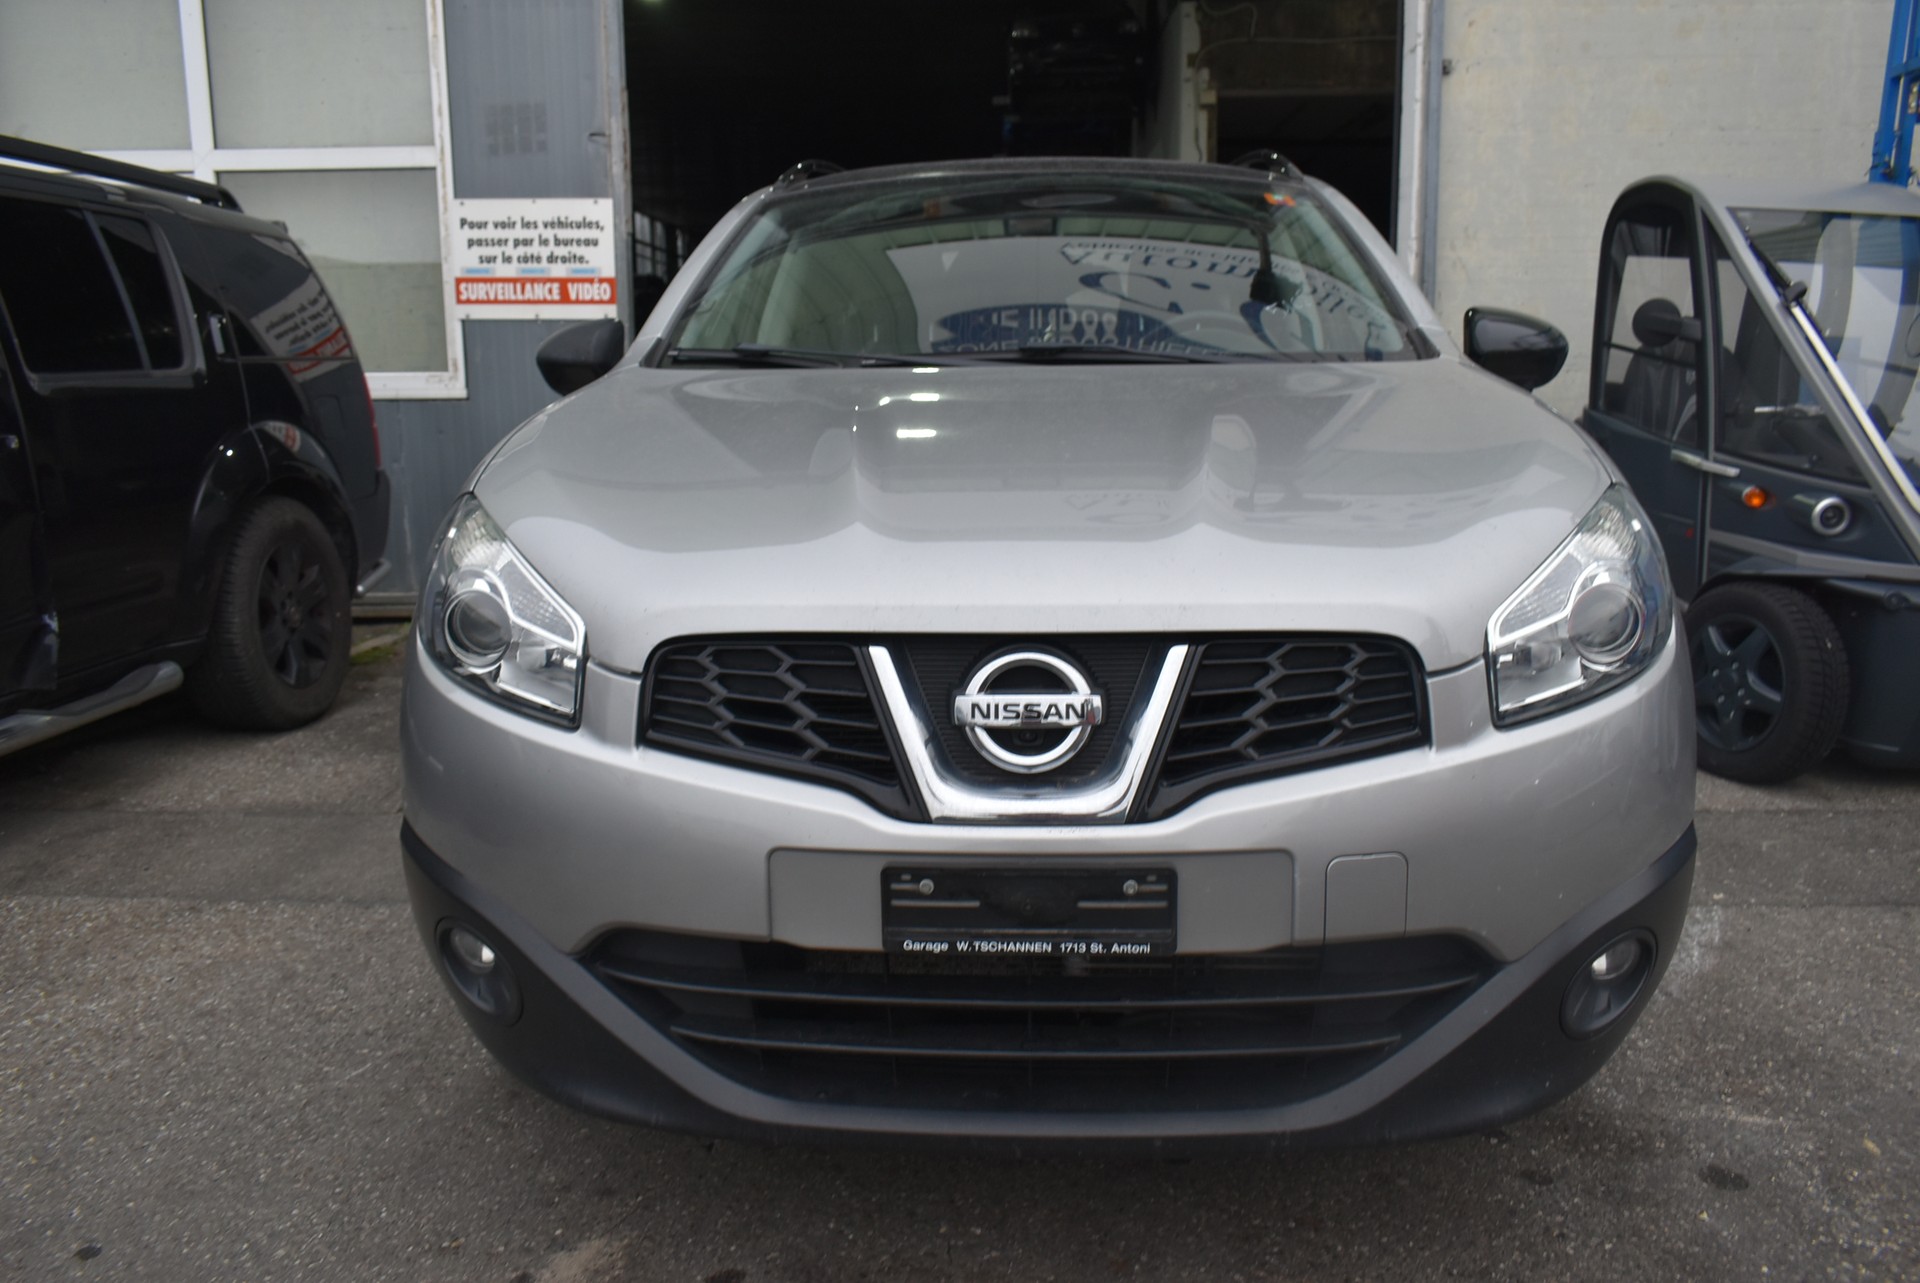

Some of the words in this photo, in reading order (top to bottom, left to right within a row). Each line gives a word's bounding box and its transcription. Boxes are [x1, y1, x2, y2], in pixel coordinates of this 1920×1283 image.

[460, 216, 488, 231] Pour
[492, 216, 516, 231] voir
[520, 215, 538, 230] les
[542, 215, 604, 232] véhicules,
[467, 235, 509, 249] passer
[513, 234, 535, 249] par
[538, 234, 549, 247] le
[554, 234, 599, 247] bureau
[478, 253, 498, 265] sur
[501, 251, 512, 264] le
[516, 251, 542, 265] côté
[546, 251, 590, 265] droite.
[458, 281, 561, 301] SURVEILLANCE
[567, 276, 612, 301] VIDÉO
[970, 702, 1085, 721] NISSAN
[903, 940, 949, 953] Garage
[1059, 942, 1087, 954] 1713
[1090, 942, 1107, 954] St.
[1110, 942, 1150, 954] Antoni
